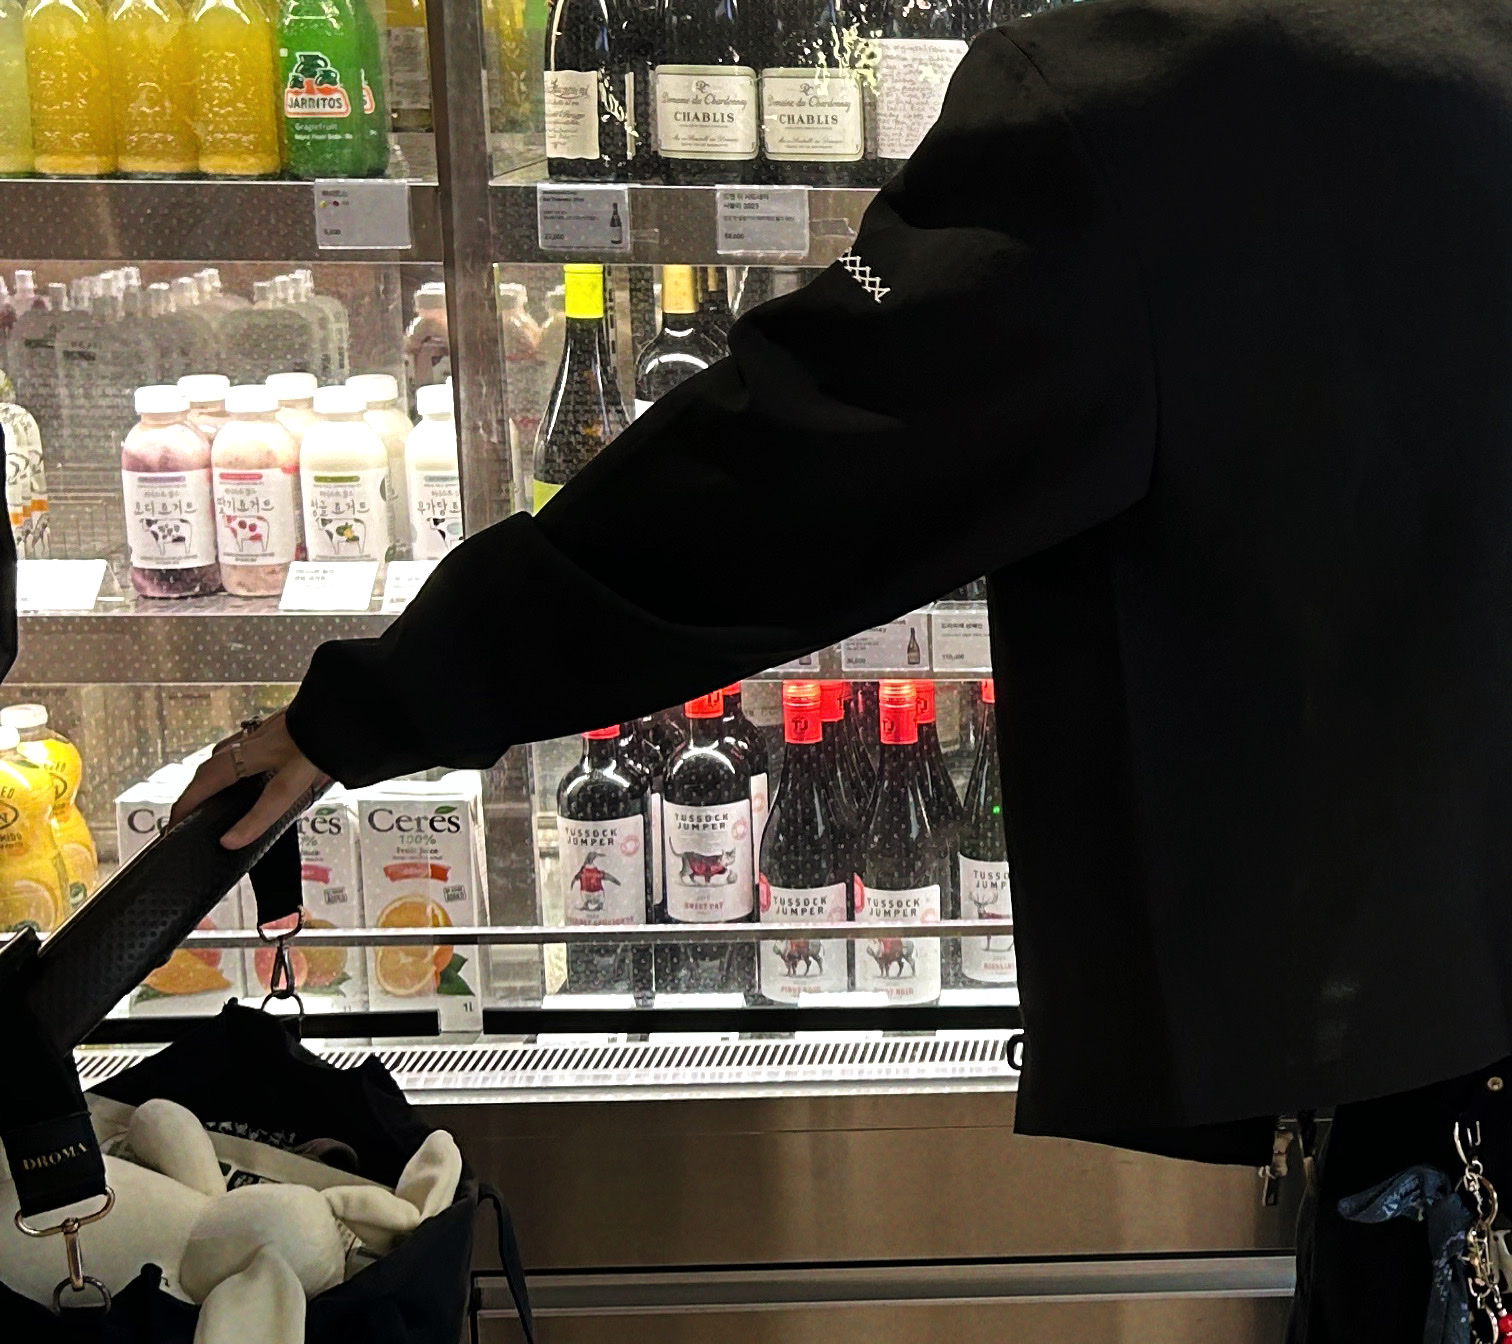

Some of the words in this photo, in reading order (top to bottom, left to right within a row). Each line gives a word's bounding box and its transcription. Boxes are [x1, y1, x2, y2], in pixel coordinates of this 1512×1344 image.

[287, 97, 343, 110] JARRITOS
[703, 92, 748, 110] Chardonnay
[673, 111, 735, 124] CHABLIS
[778, 113, 839, 126] CHABLIS
[157, 499, 198, 517] 요거트
[236, 496, 276, 513] 요거트
[674, 812, 729, 823] TUSSOCK
[297, 814, 343, 836] res
[677, 821, 726, 831] JUMPER
[565, 827, 618, 839] TUSSOCK
[398, 834, 437, 846] 100%
[567, 837, 615, 847] JUMPER
[973, 869, 1009, 881] TUSSO
[975, 879, 1008, 890] JUMP
[772, 895, 828, 907] TUSSOCK
[866, 896, 921, 908] TUSSOCK
[775, 905, 825, 916] JUMPER
[869, 906, 918, 918] JUMPER
